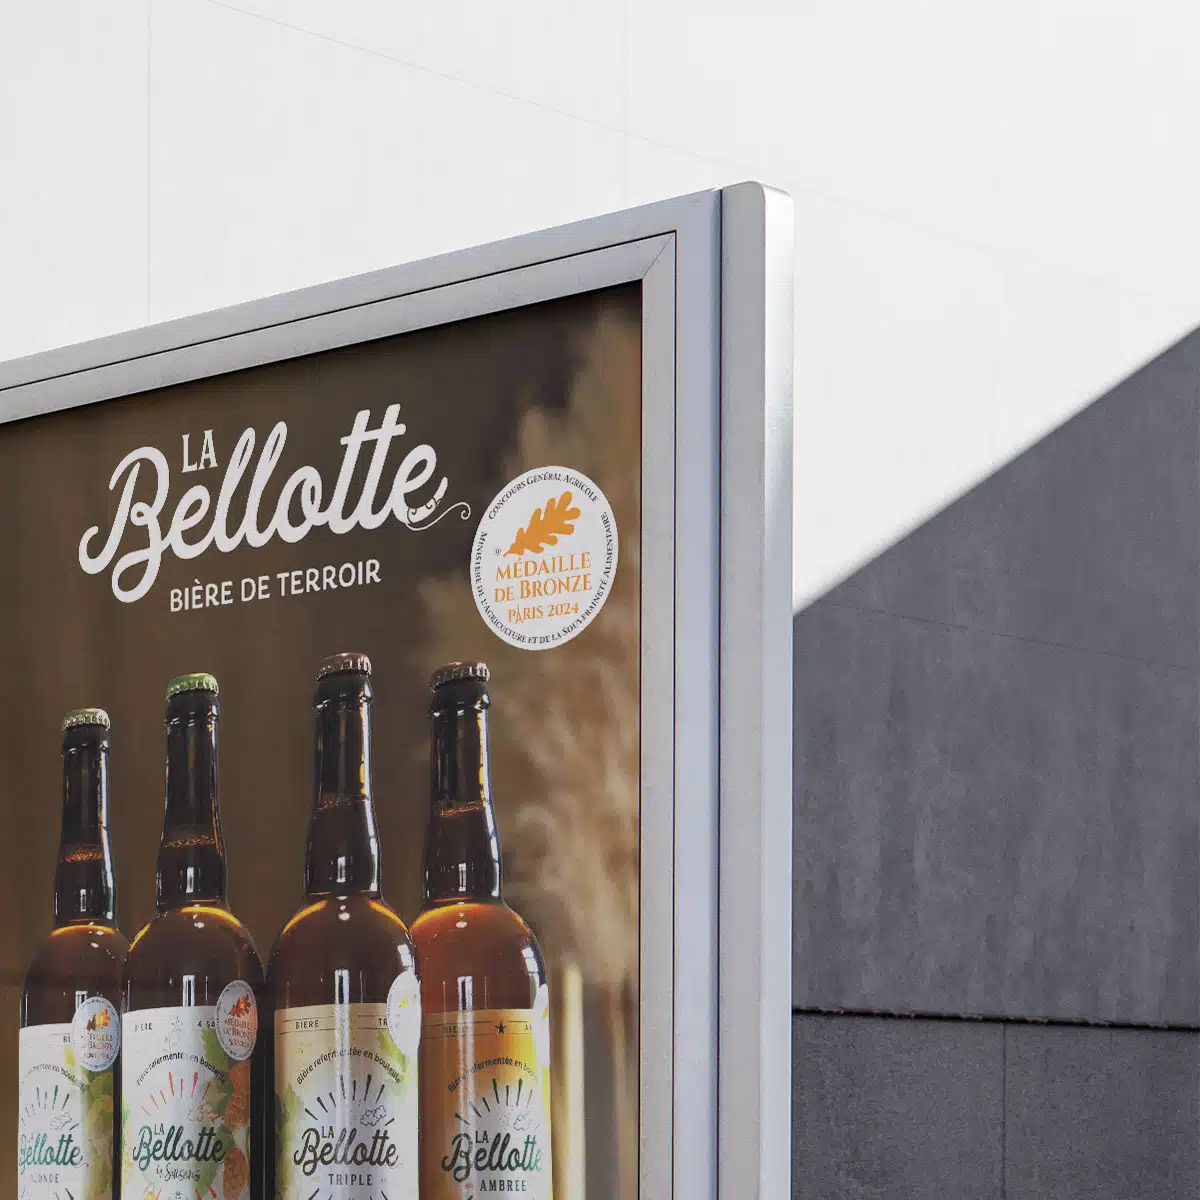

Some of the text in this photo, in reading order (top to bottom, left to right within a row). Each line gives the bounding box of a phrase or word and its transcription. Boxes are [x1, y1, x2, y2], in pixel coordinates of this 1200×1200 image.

[182, 430, 218, 473] LA
[78, 404, 468, 603] Bellotte
[488, 480, 526, 520] CONCOURS
[562, 474, 598, 503] AGRICOLE
[495, 552, 592, 582] MÉDAILLE
[170, 558, 382, 612] BIÈRE DE TERROIR
[493, 574, 592, 603] DE BRONZE
[508, 602, 580, 624] PARIS 2024
[364, 1050, 372, 1060] en
[154, 1124, 164, 1136] LA
[322, 1126, 334, 1138] LA
[476, 1130, 489, 1144] LA
[133, 1125, 226, 1172] Bellotte
[294, 1128, 402, 1176] Bellotte
[328, 1174, 372, 1186] TRIPLE
